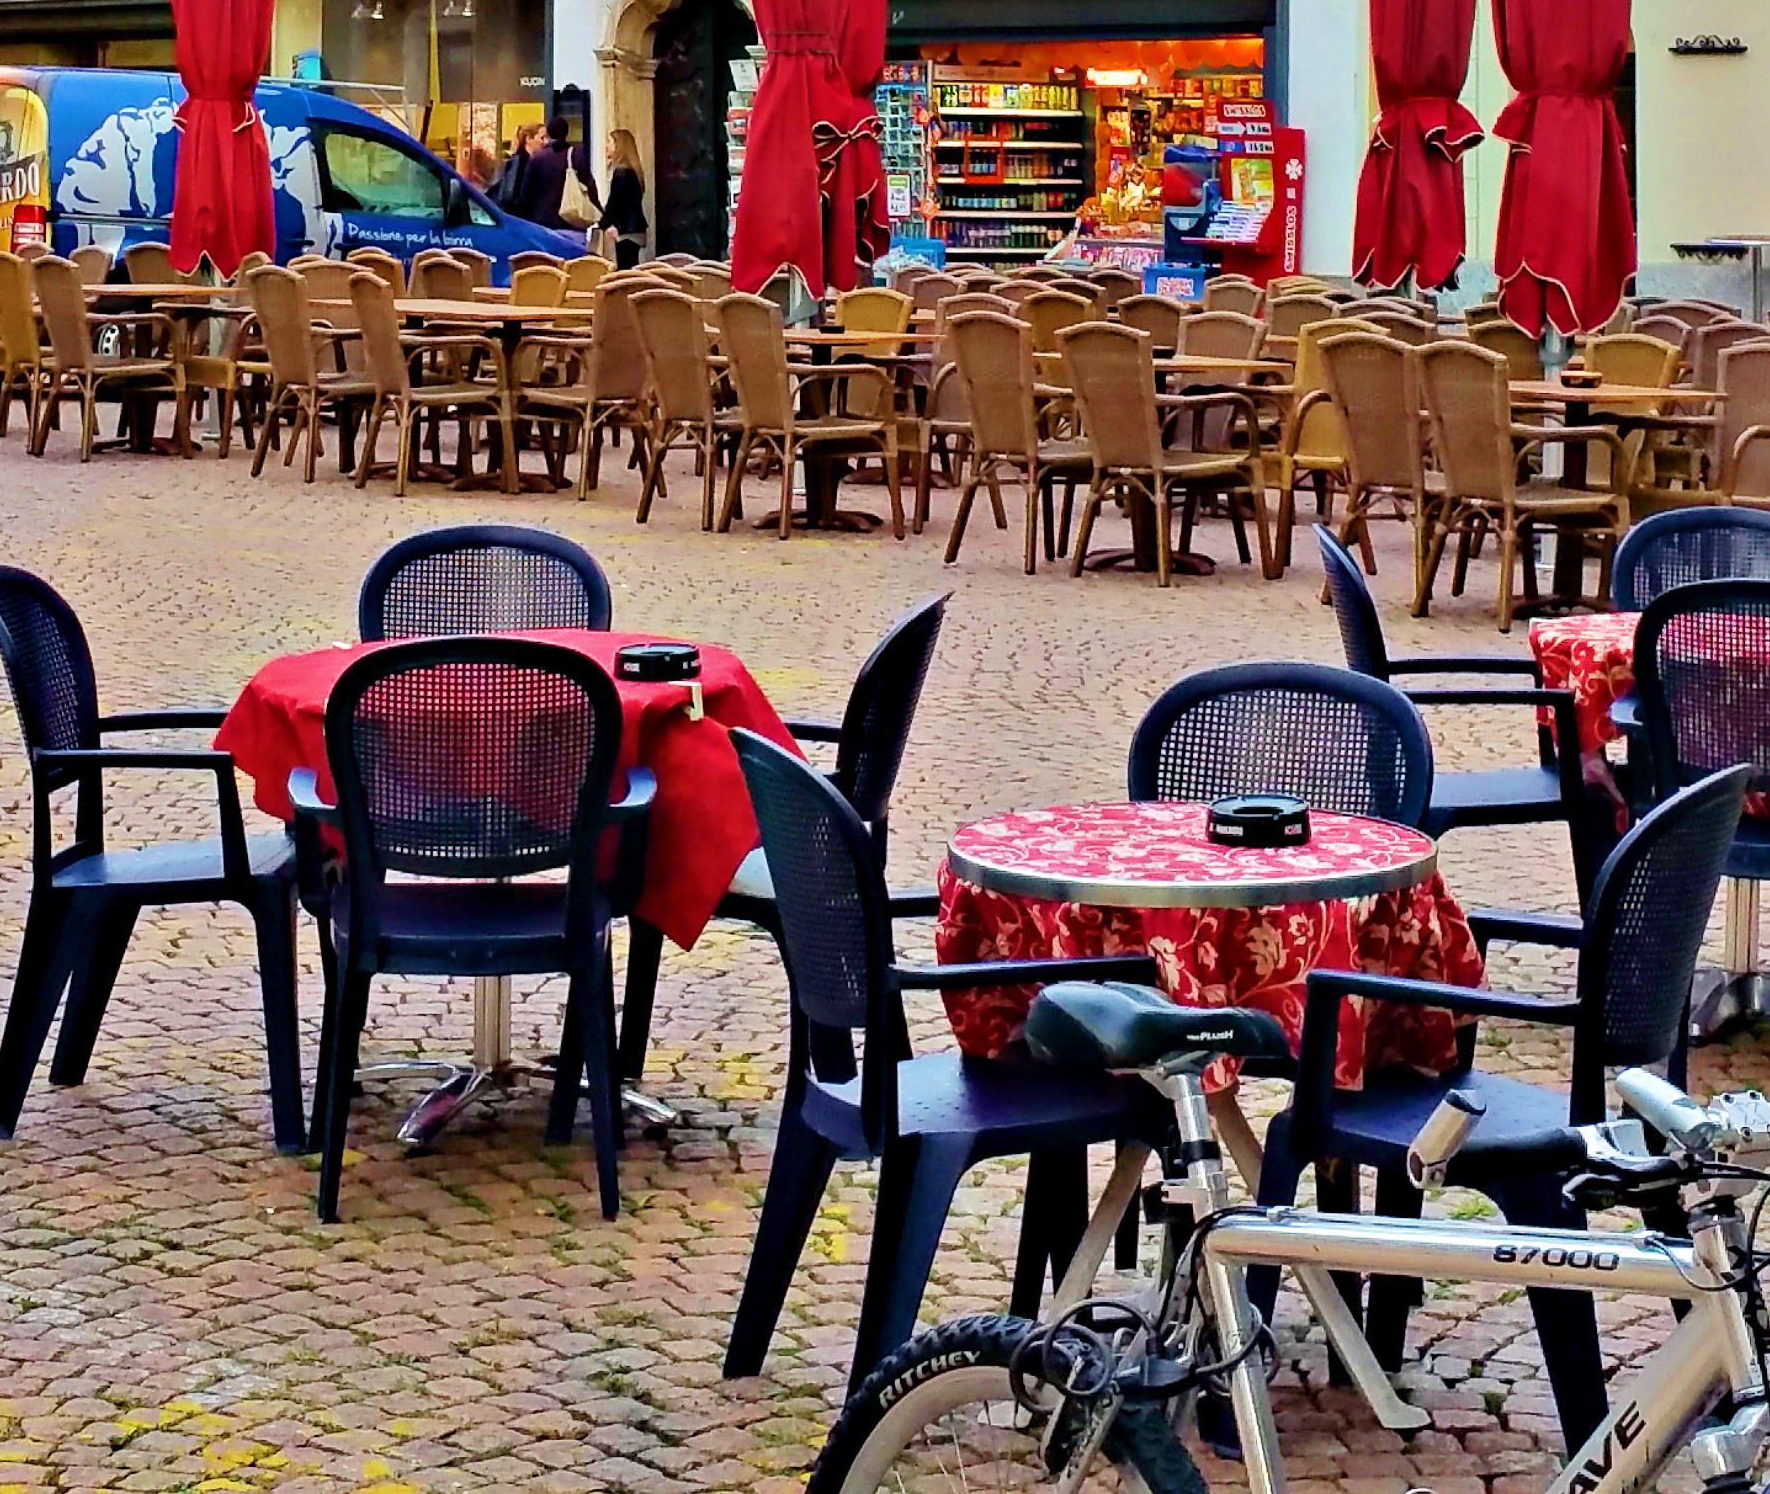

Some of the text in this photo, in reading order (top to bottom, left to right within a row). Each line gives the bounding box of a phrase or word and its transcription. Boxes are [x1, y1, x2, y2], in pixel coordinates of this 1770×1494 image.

[348, 222, 405, 242] Passione
[406, 233, 428, 248] per
[429, 230, 441, 245] la
[878, 1350, 982, 1410] RITCHEY
